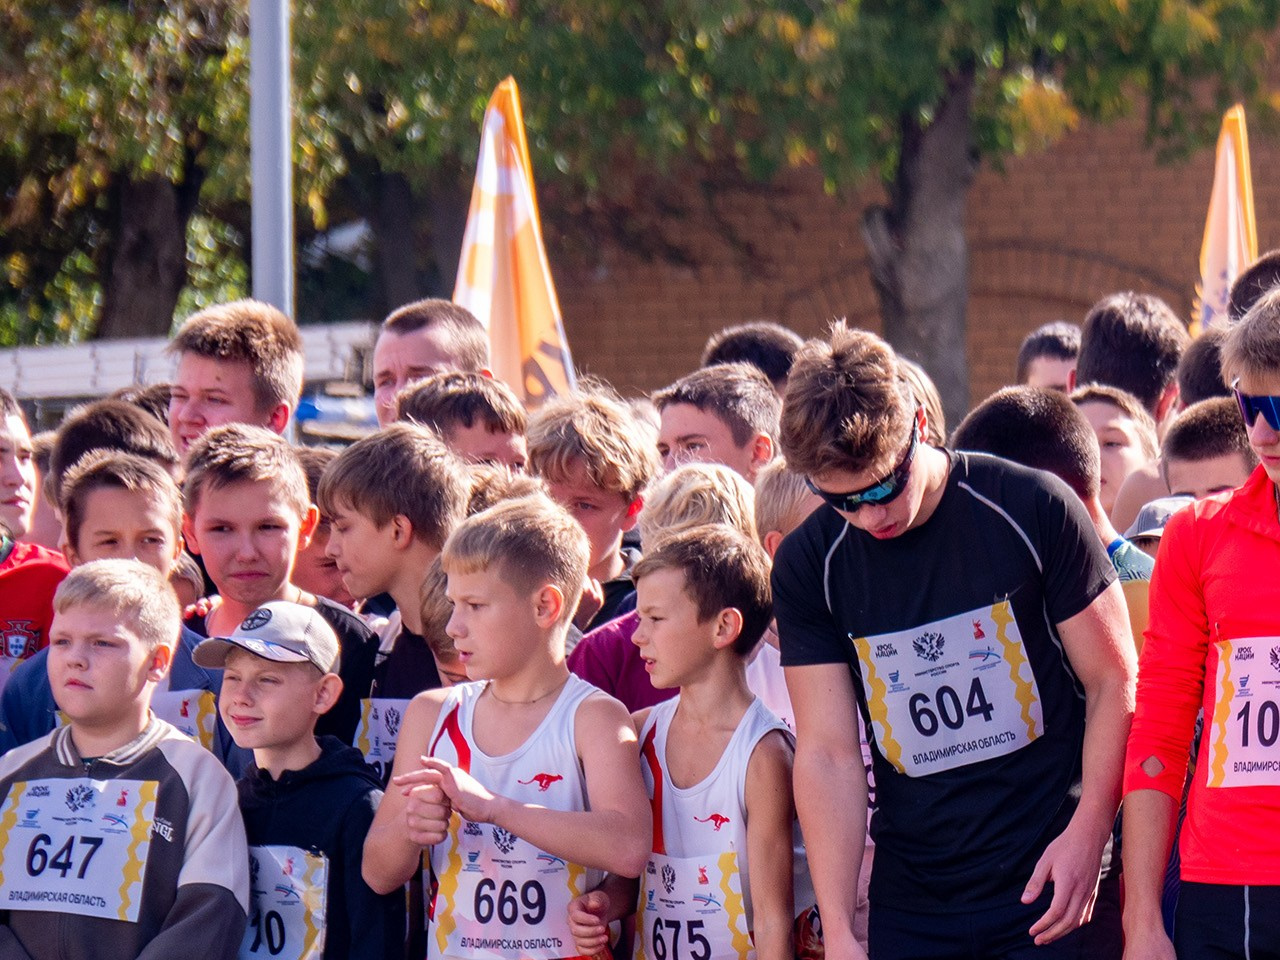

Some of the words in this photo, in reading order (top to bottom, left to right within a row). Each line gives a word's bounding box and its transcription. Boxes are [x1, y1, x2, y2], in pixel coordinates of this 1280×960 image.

[908, 677, 994, 738] 604
[912, 741, 979, 765] ВЛАДИМИРСКАЯ
[978, 731, 1016, 749] ОБЛАСТЬ
[26, 833, 104, 879] 647
[9, 890, 68, 902] ВЛАДИМИРСКАЯ
[68, 893, 106, 908] ОБЛАСТЬ
[474, 878, 547, 925] 669
[460, 937, 522, 950] ВЛАДИМИРСКАЯ
[523, 937, 563, 949] ОБЛАСТЬ
